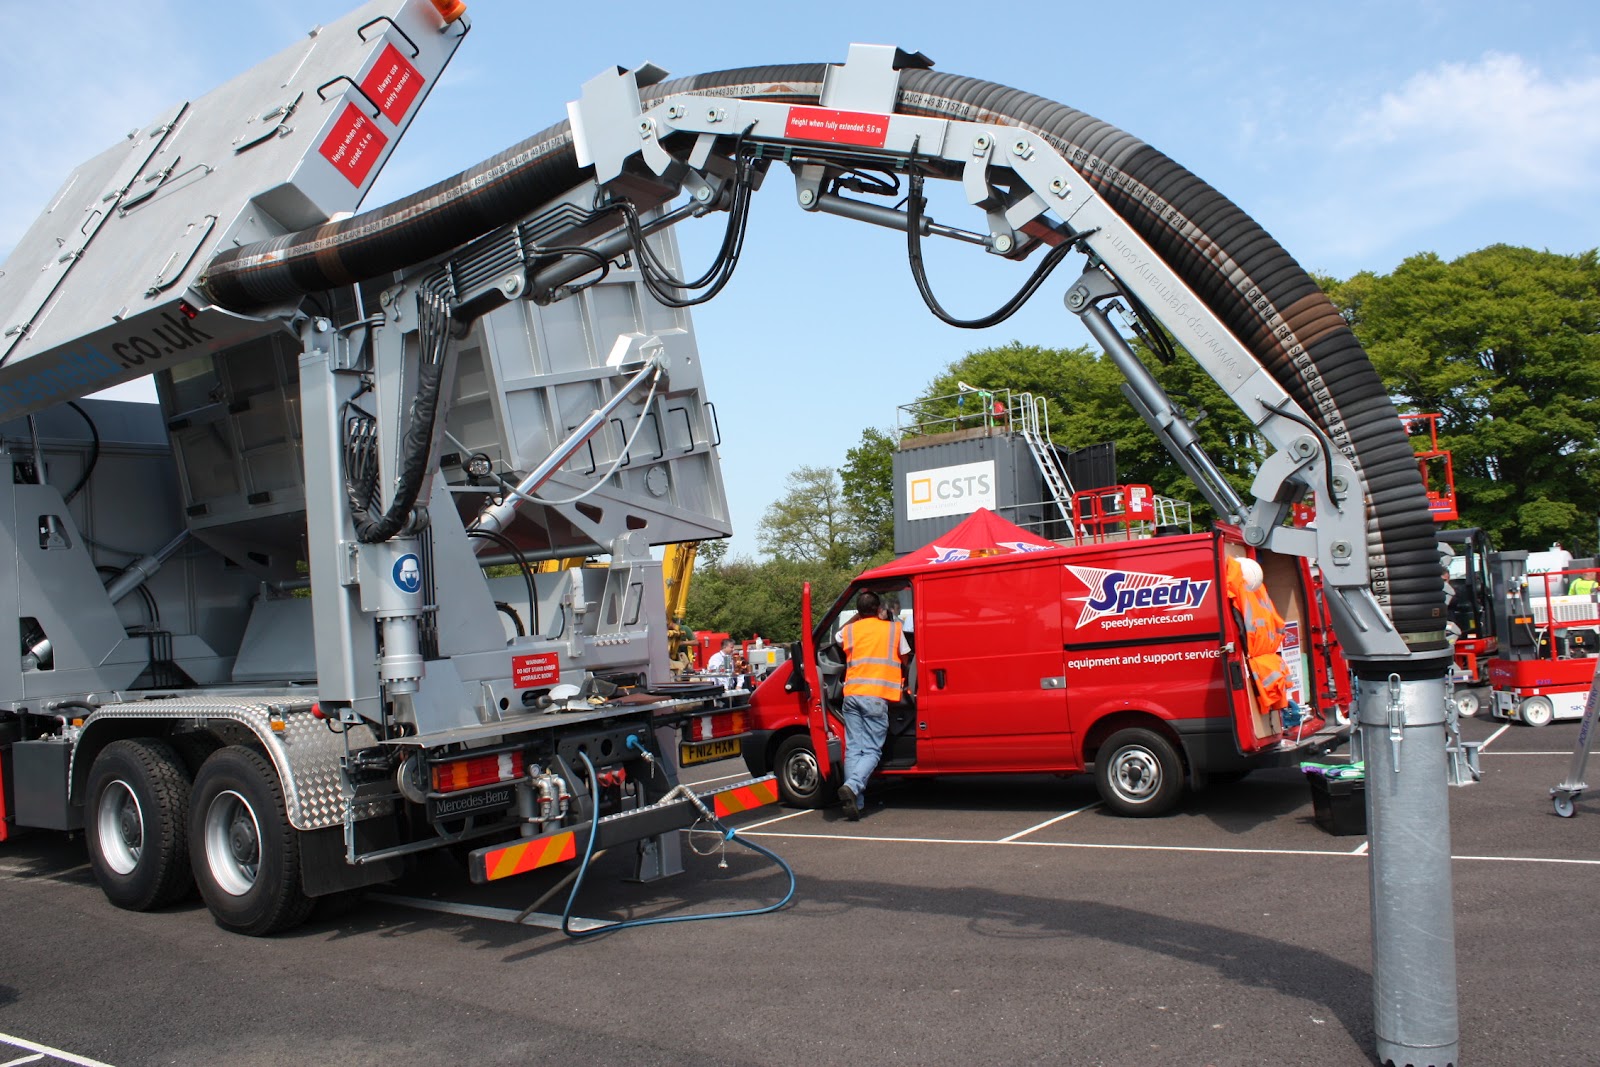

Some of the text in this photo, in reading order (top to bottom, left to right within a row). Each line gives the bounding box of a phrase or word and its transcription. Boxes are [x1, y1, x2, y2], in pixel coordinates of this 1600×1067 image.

[377, 74, 393, 94] Always
[384, 91, 398, 110] safety
[791, 117, 808, 127] Height
[809, 119, 824, 128] when
[825, 120, 838, 131] fully
[839, 122, 865, 132] extended:
[331, 115, 366, 163] Height when fully
[1248, 288, 1278, 325] ORIGINAL
[1277, 326, 1293, 343] RSP
[1291, 346, 1331, 410] SAUGSCHLAUCH
[936, 473, 990, 500] CSTS
[1088, 572, 1209, 613] Speedy
[1101, 613, 1194, 630] speedyservices.com
[1068, 655, 1120, 669] equipment
[1122, 653, 1141, 665] and
[1143, 650, 1182, 664] support
[689, 745, 713, 759] FN12
[436, 790, 509, 814] Mercedes-Benz
